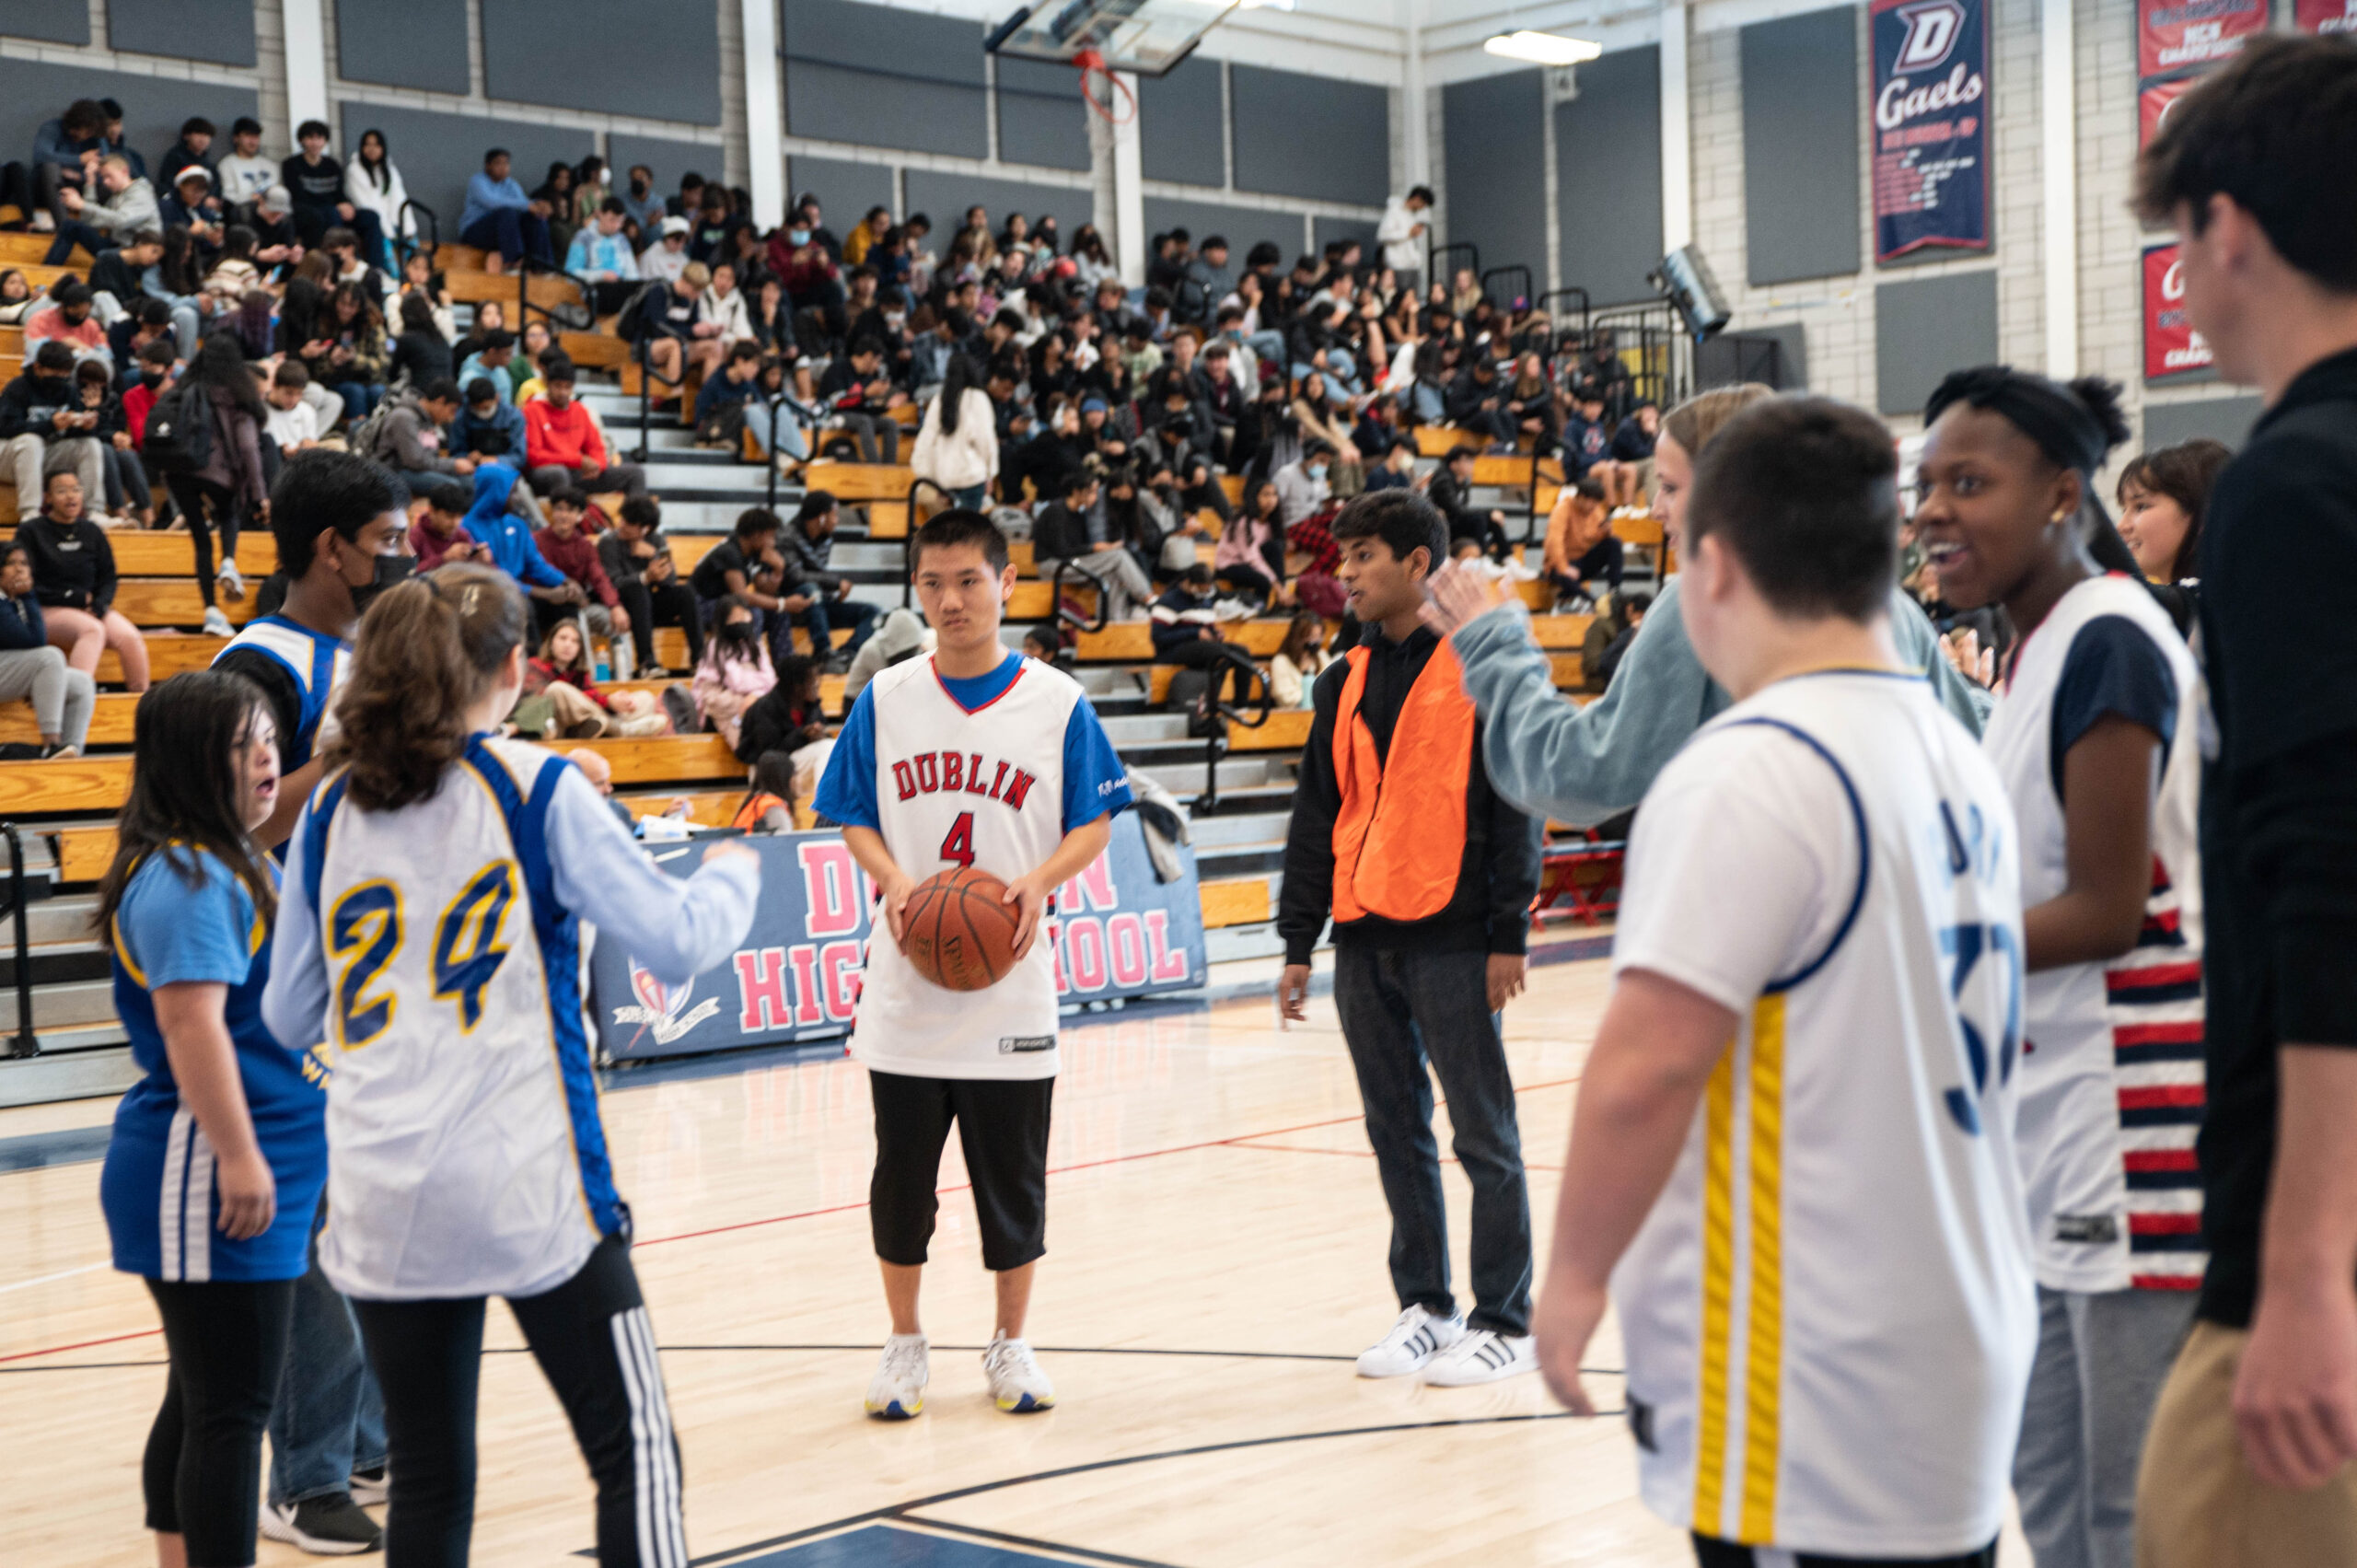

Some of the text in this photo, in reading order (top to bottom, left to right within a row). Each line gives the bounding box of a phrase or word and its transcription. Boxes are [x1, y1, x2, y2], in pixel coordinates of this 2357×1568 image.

[1892, 0, 1967, 75] D
[1875, 62, 1983, 129] Gaels
[891, 750, 1037, 812] DUBLIN
[939, 810, 975, 869] 4
[326, 857, 519, 1052] 24
[733, 939, 871, 1034] HIG
[1052, 908, 1190, 996] OOL
